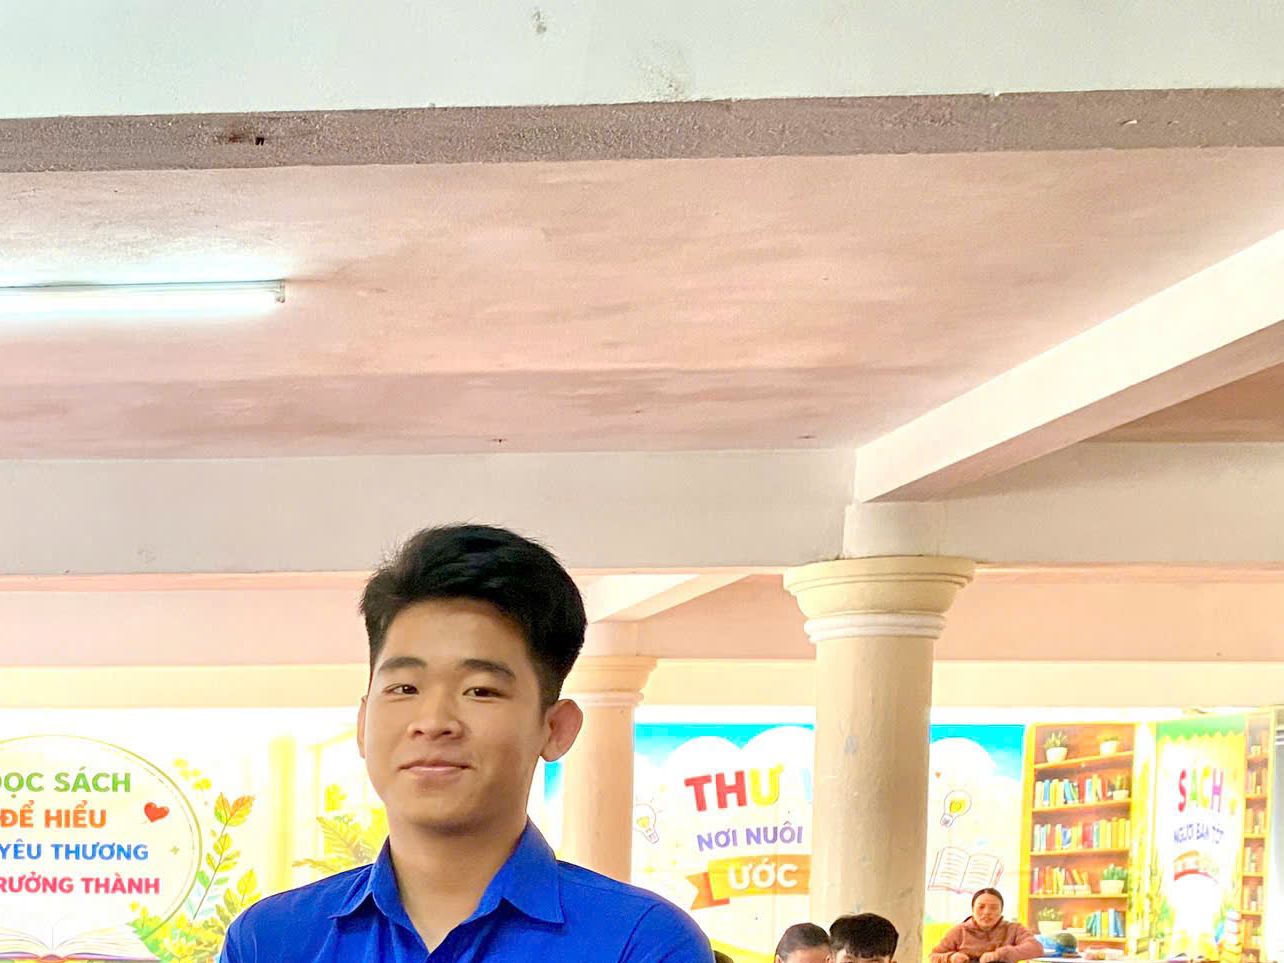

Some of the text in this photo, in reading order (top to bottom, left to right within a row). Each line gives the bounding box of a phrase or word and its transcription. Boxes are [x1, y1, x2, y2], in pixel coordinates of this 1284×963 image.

[54, 766, 131, 792] SÁCH
[684, 763, 784, 812] THƯ
[44, 799, 106, 828] HIỂU
[697, 820, 803, 852] NƠI NUÔI
[50, 842, 149, 860] THƯƠNG
[80, 872, 161, 894] THÀNH
[727, 857, 799, 891] ƯỚC
